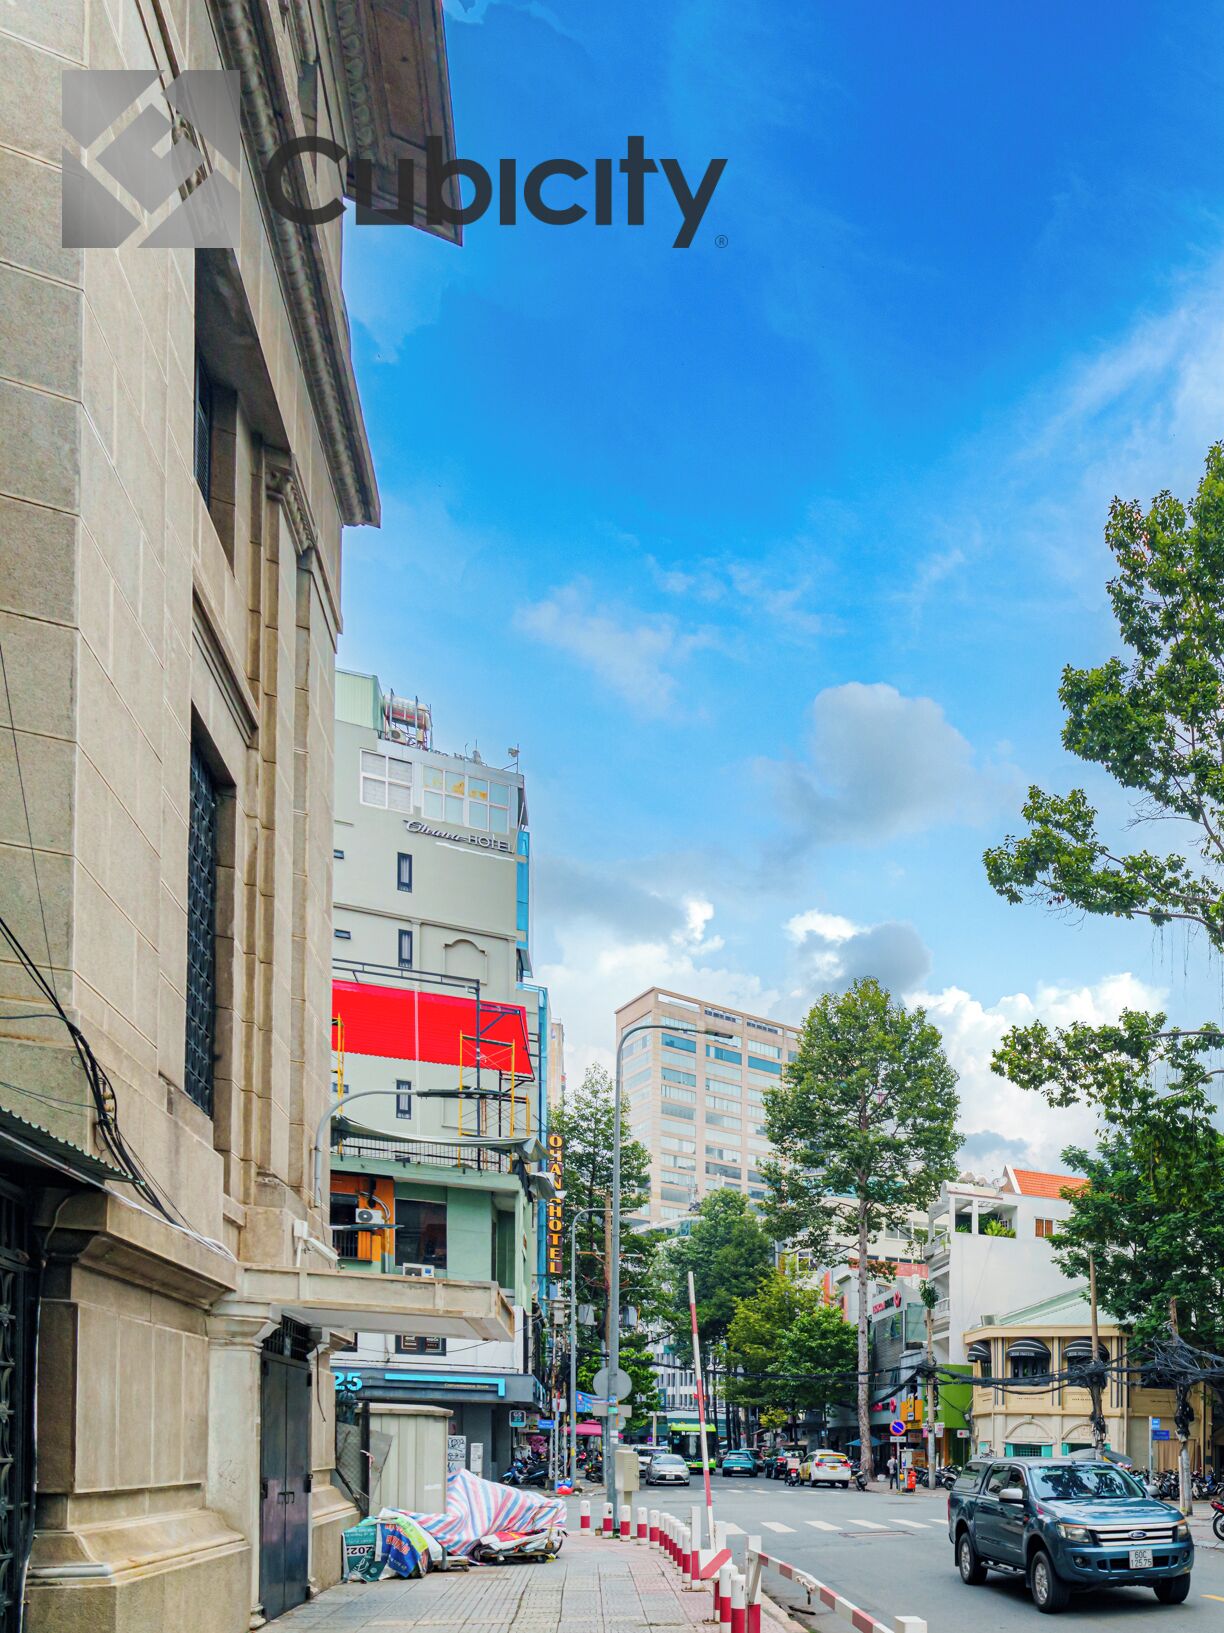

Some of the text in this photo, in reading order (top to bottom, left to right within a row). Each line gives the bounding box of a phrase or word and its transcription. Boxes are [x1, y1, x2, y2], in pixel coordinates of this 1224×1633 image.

[468, 834, 515, 853] HOTEL
[548, 1205, 562, 1274] HOTEL
[1134, 1550, 1147, 1559] 60C
